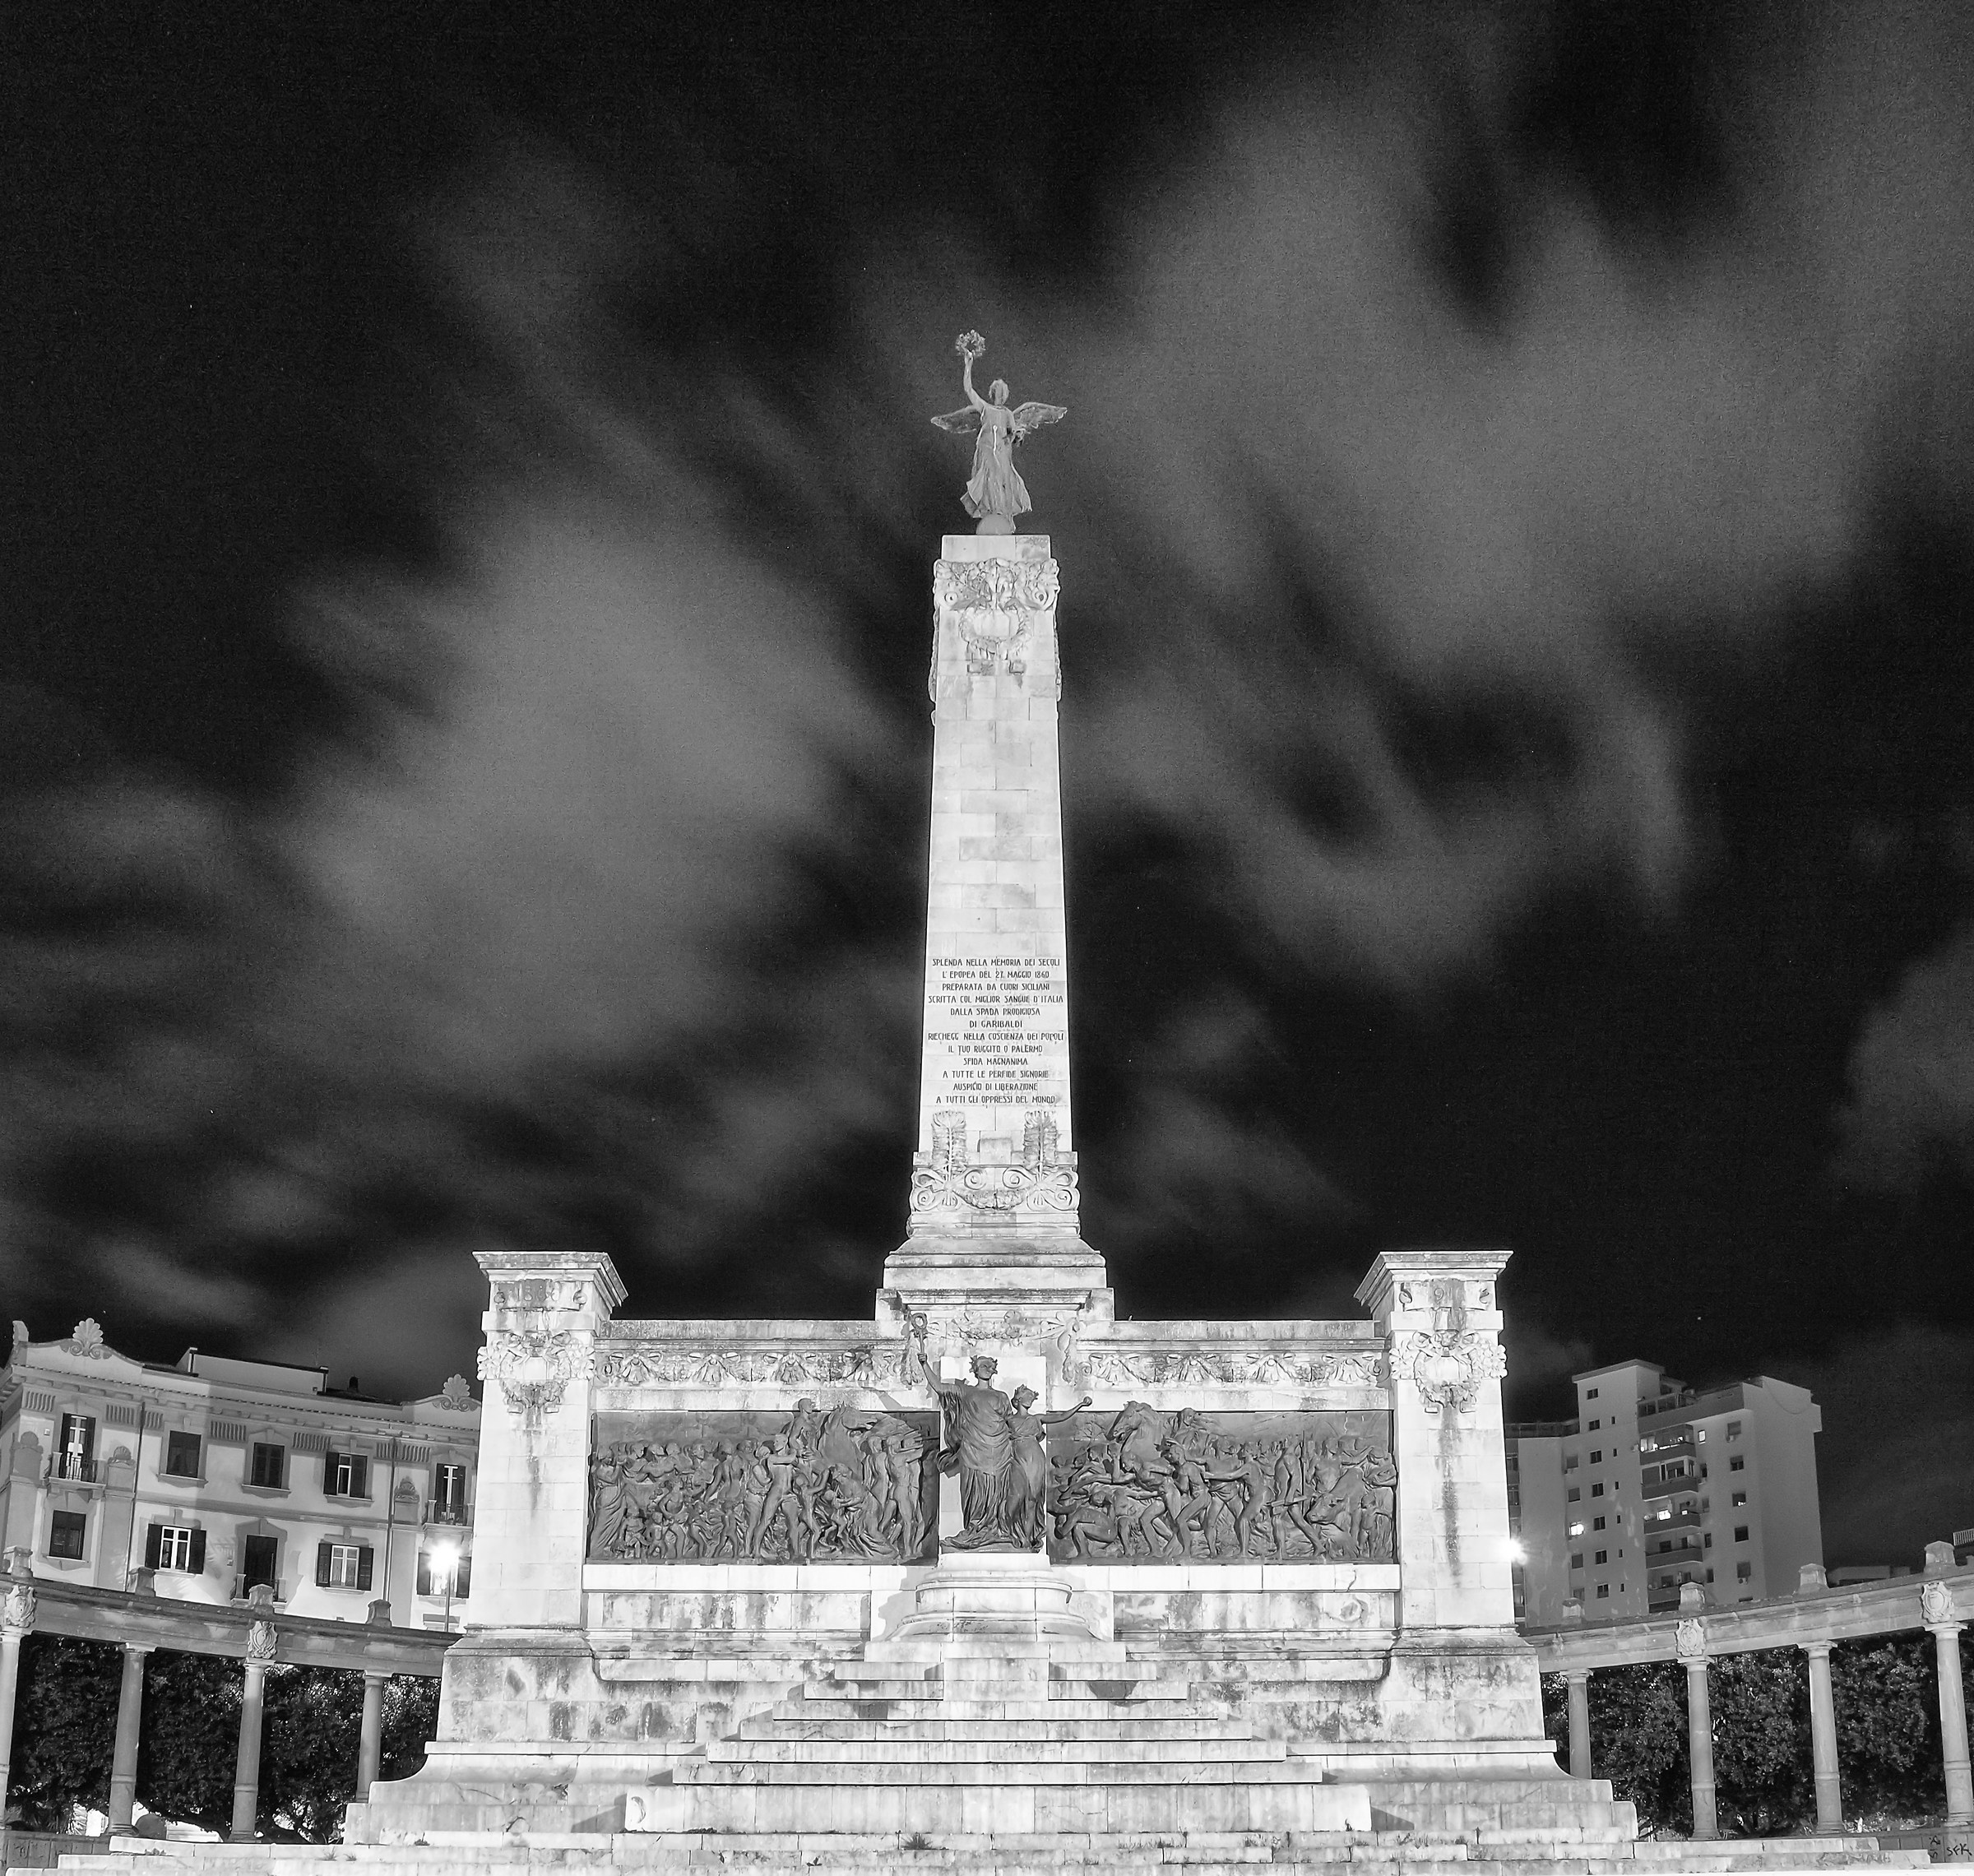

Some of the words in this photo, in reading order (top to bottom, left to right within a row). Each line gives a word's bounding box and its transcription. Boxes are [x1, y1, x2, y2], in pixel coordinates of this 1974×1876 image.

[931, 958, 963, 966] SPLENDA
[966, 958, 988, 966] NELLA
[990, 958, 1022, 966] MEMORIA
[1024, 958, 1036, 966] DEI
[1038, 958, 1060, 966] SECOLI
[949, 970, 976, 979] EPOPEA
[979, 970, 992, 979] DEL
[1007, 970, 1031, 979] MAGGIO
[1034, 970, 1050, 979] 1860
[942, 983, 983, 991] PREPARATA
[986, 983, 997, 991] DA
[999, 983, 1018, 991] CUORI
[1021, 983, 1050, 991] SICILIANI
[928, 995, 957, 1003] SCRITTA
[960, 995, 972, 1003] COL
[975, 995, 1001, 1003] MIGLIOR
[1003, 995, 1031, 1003] SANGUE
[950, 1007, 973, 1017] DALLA
[975, 1007, 999, 1017] SPADA
[1003, 1007, 1040, 1017] PRODIGIOSA
[969, 1020, 977, 1029] DI
[980, 1020, 1023, 1029] GARIBALDI
[963, 1032, 985, 1041] NELLA
[988, 1032, 1024, 1041] COSCIENZA
[1026, 1032, 1039, 1041] DEI
[1040, 1032, 1064, 1041] POPOLI
[948, 1045, 954, 1054] IL
[957, 1045, 971, 1054] TUO
[973, 1045, 1001, 1054] RUGGITO
[1003, 1045, 1008, 1054] O
[1011, 1045, 1043, 1054] PALERMO
[963, 1057, 984, 1066] SFIDA
[986, 1057, 1028, 1066] MAGNANIMA
[942, 1070, 948, 1078] A
[952, 1070, 974, 1078] TUTTE
[977, 1070, 985, 1078] LE
[989, 1070, 1017, 1078] PERFIDE
[1019, 1070, 1049, 1078] SIGNORIE
[952, 1082, 982, 1091] AUSPICIO
[985, 1082, 992, 1091] DI
[994, 1082, 1039, 1091] LIBERAZIONE
[935, 1095, 942, 1104] A
[945, 1095, 966, 1104] TUTTI
[968, 1095, 979, 1104] GLI
[980, 1095, 1012, 1104] OPPRESSI
[1015, 1095, 1029, 1104] DEL
[1031, 1095, 1055, 1104] MONDO
